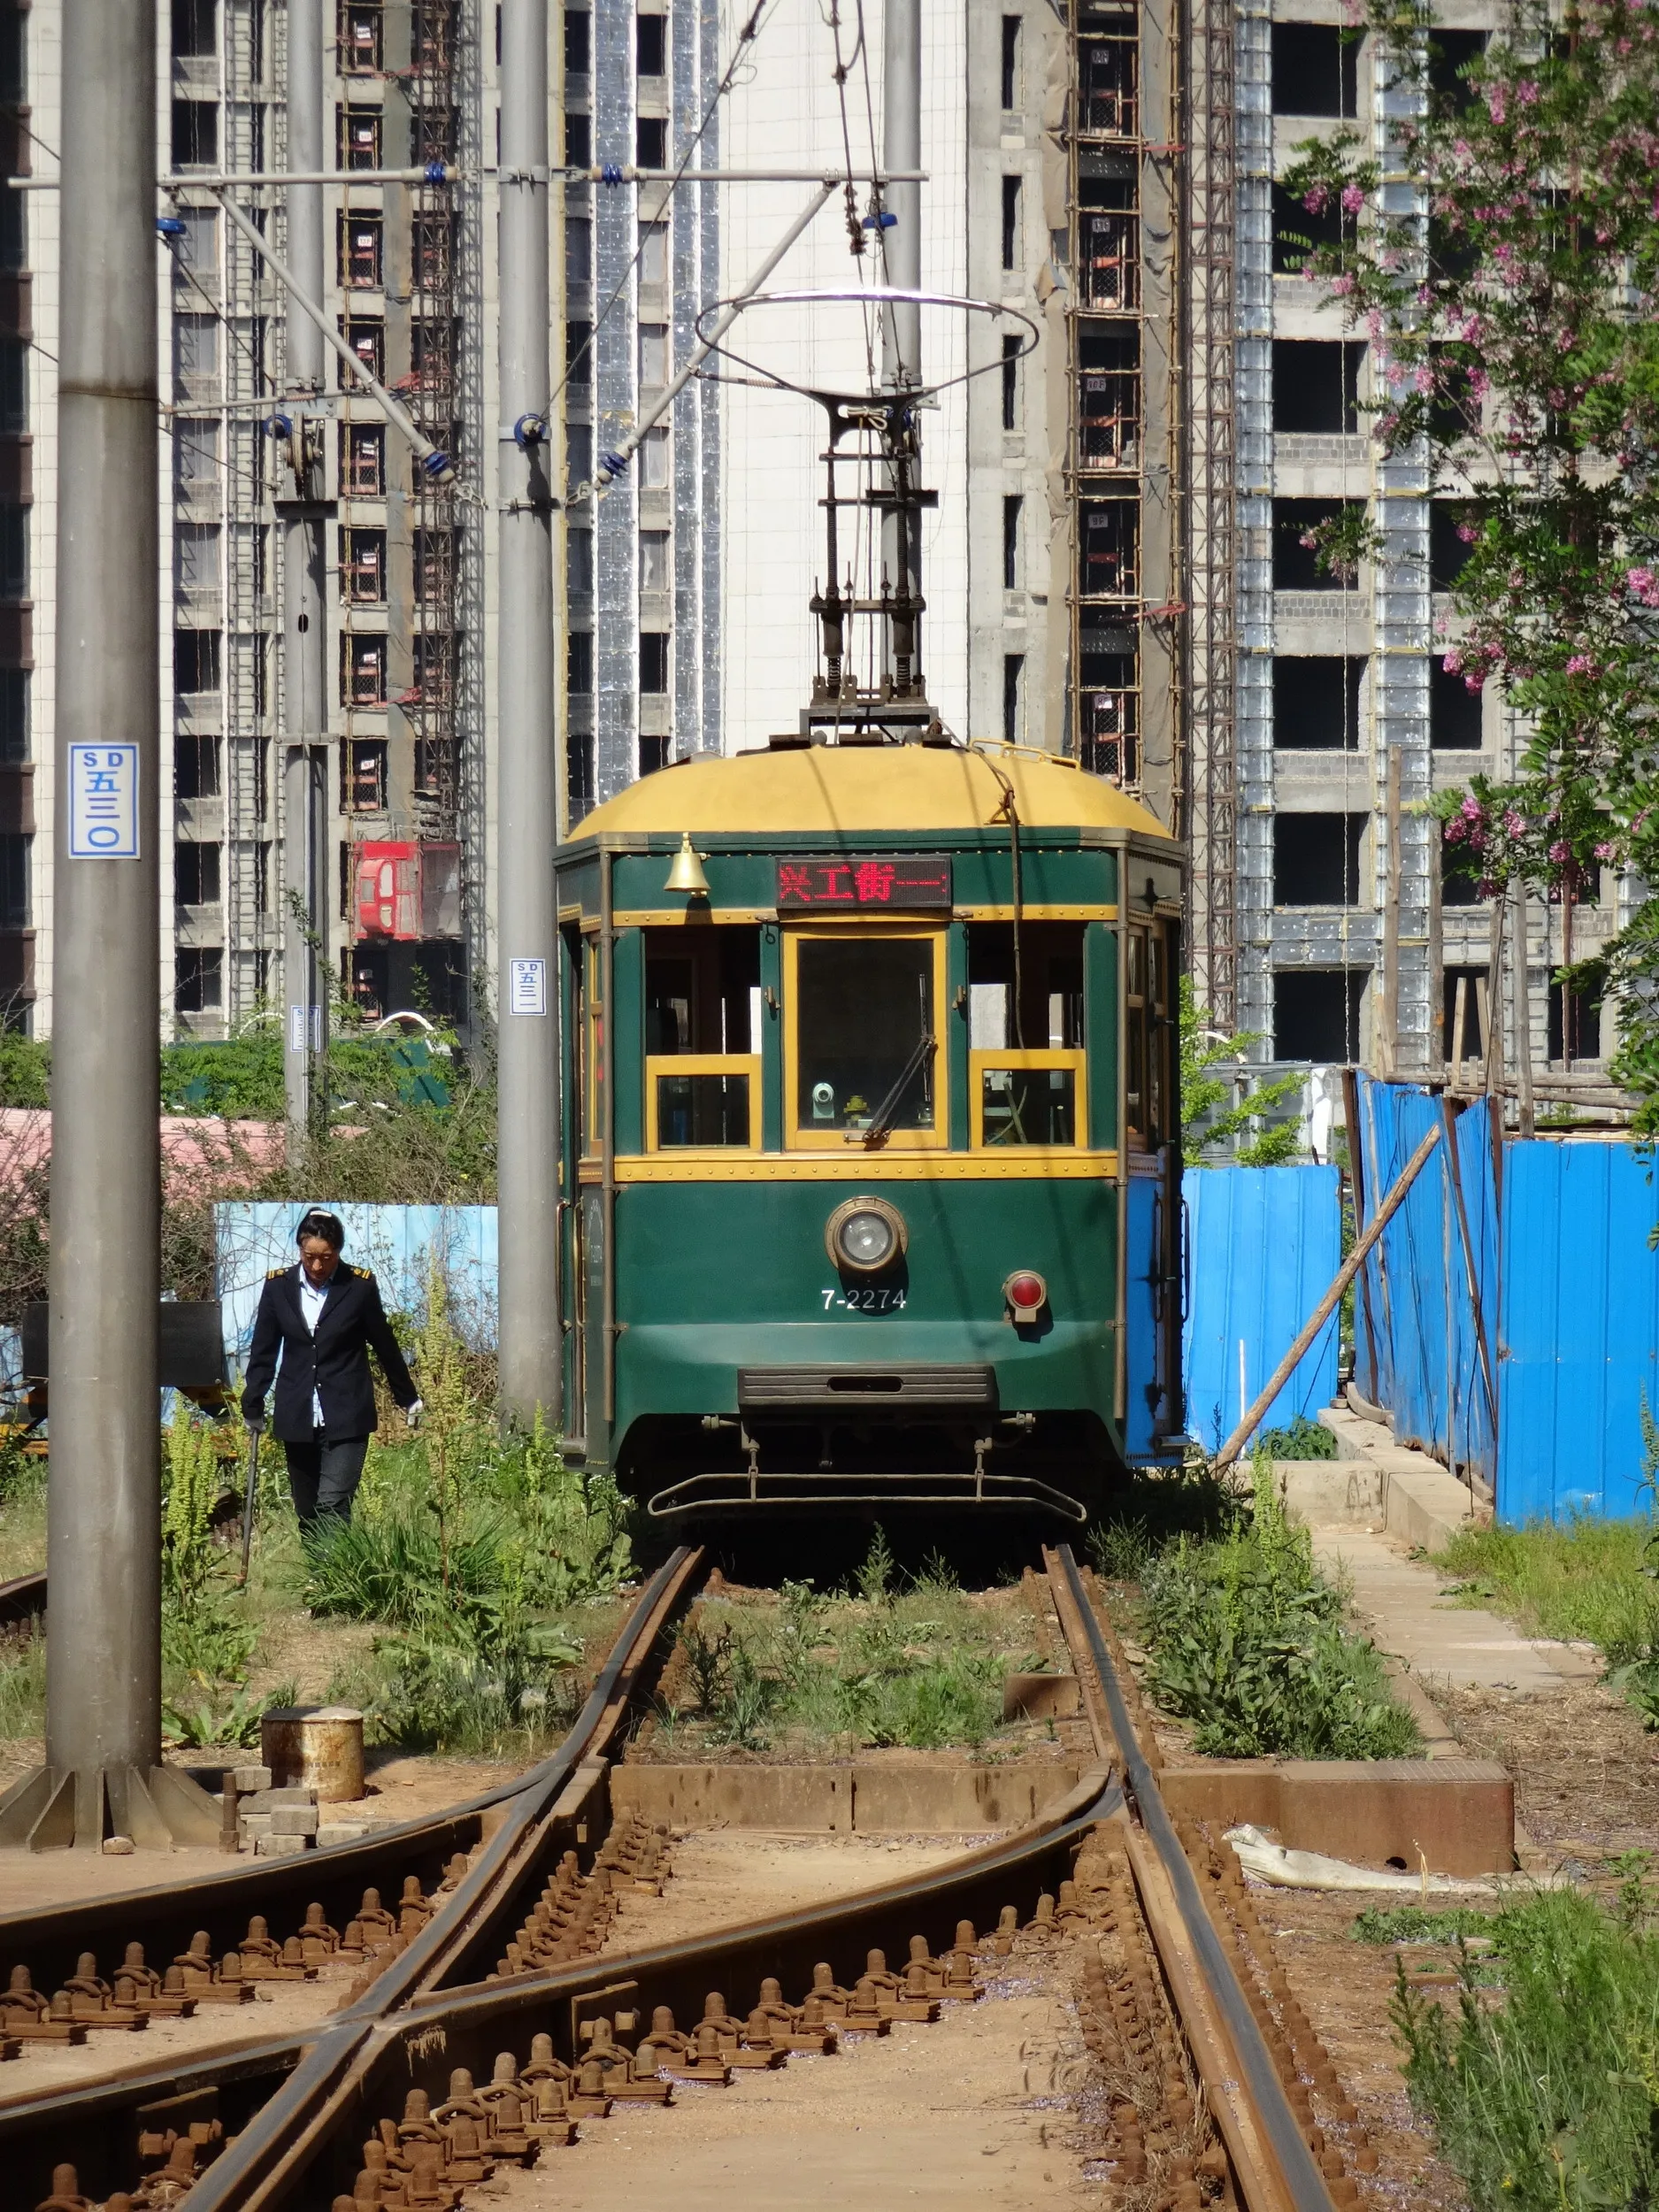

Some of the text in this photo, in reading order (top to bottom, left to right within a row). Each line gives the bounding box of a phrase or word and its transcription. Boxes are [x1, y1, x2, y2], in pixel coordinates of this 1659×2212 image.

[1088, 380, 1104, 389] 10F
[1093, 517, 1104, 526] 9F
[821, 1288, 907, 1310] 7-2274
